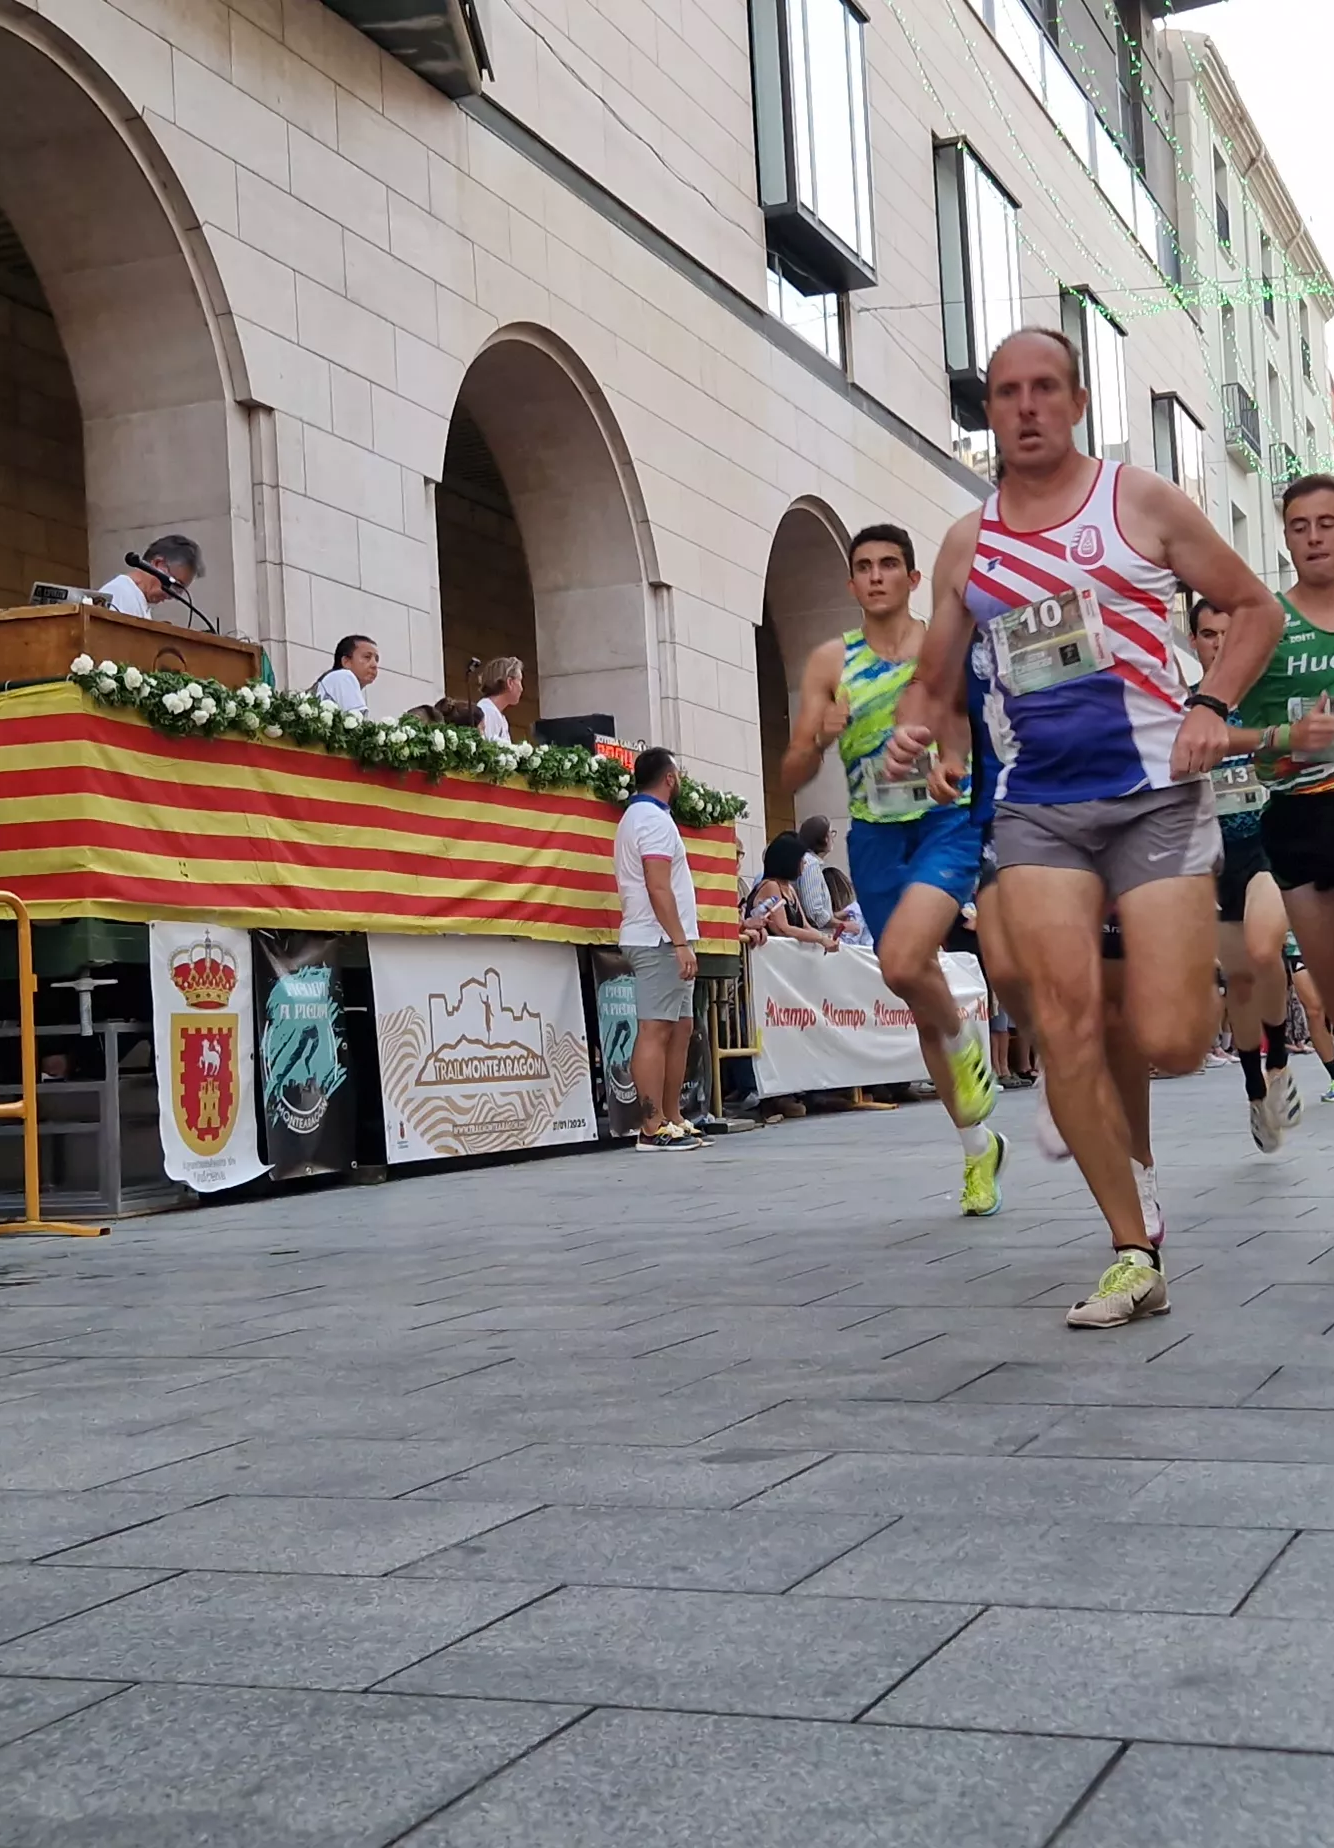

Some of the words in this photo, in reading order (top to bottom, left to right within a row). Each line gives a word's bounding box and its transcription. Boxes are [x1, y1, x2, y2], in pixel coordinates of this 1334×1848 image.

[1020, 599, 1062, 634] 10
[1223, 766, 1249, 784] 13
[765, 996, 817, 1031] Alcampo
[822, 998, 867, 1031] Alcampo
